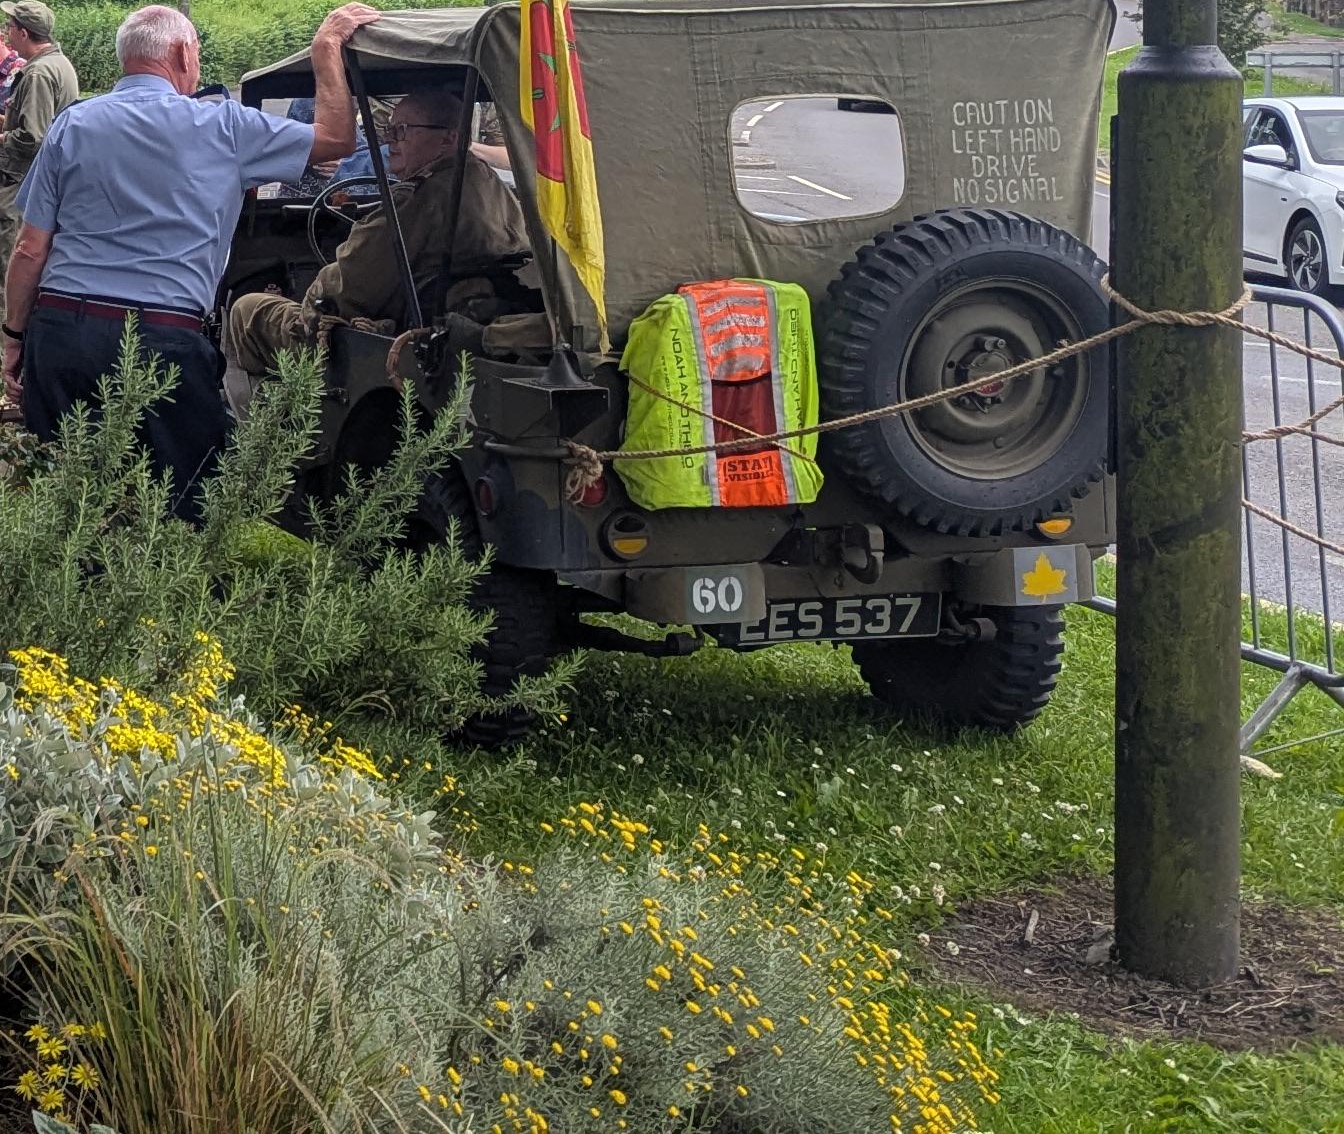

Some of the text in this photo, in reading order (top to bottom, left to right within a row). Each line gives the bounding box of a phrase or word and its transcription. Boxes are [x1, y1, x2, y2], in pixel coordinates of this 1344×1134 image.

[952, 98, 1053, 126] CAUTION
[951, 126, 1061, 154] LEFT HAND
[971, 154, 1039, 177] DRIVE
[984, 177, 1063, 203] SIGNAL
[670, 328, 687, 379] NOAH
[692, 576, 743, 614] 60
[835, 597, 922, 635] 537
